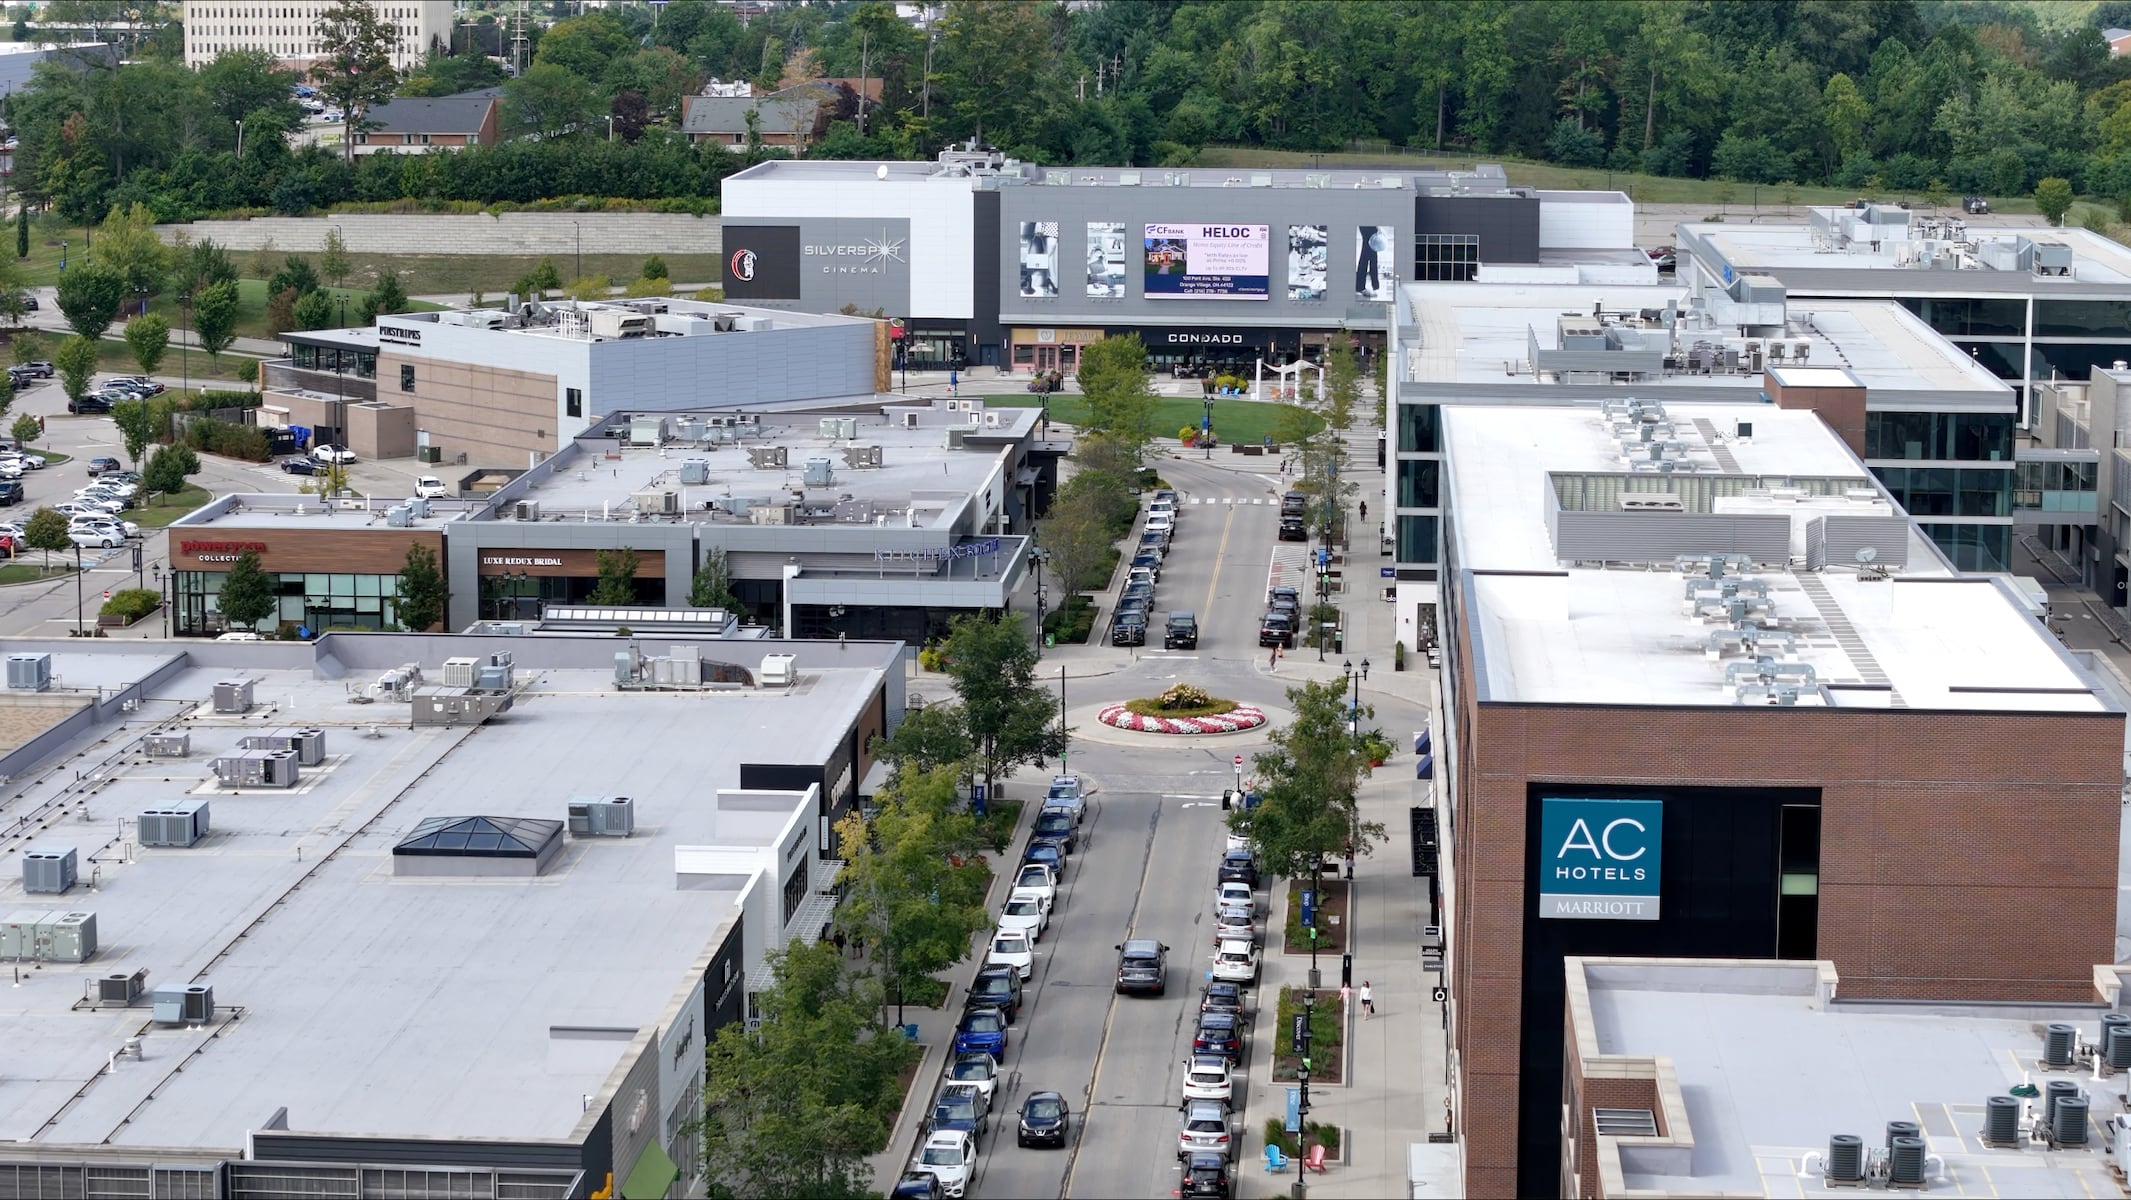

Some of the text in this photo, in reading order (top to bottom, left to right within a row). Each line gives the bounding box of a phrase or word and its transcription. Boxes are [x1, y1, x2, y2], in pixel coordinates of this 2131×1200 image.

[1203, 227, 1250, 238] HELOC
[823, 266, 878, 274] CINEMA
[379, 326, 421, 340] PINSTRIPES
[1168, 334, 1243, 343] CONDADO
[874, 546, 960, 561] KITCHEN
[483, 557, 563, 566] LUXE REDUX BRIDAL
[1557, 817, 1647, 861] AC
[1556, 866, 1646, 881] HOTELS
[1556, 901, 1645, 915] MARRIOTT
